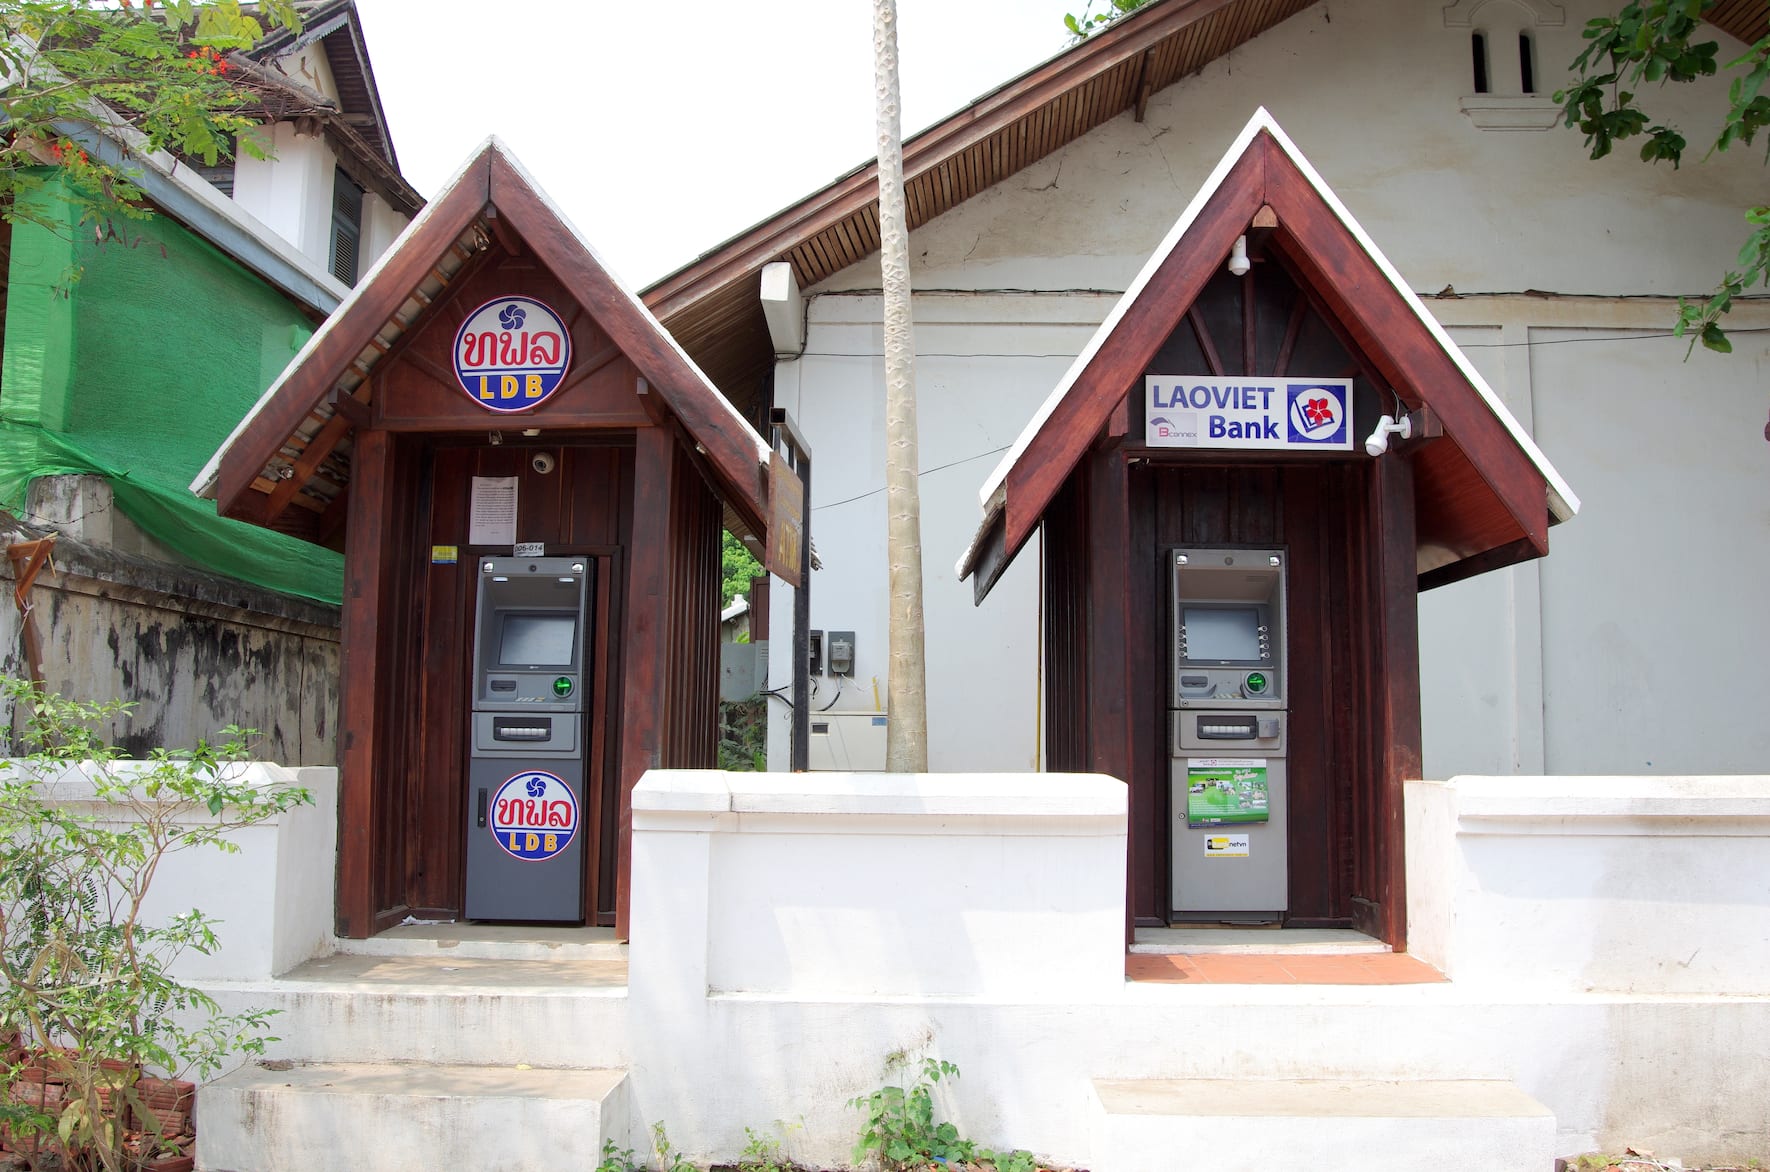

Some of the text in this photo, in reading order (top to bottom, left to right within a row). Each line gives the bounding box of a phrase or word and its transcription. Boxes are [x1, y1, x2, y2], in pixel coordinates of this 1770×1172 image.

[463, 331, 561, 367] ທພລ
[479, 374, 543, 400] LDB
[1153, 385, 1275, 410] LAOVIET
[1209, 415, 1281, 440] Bank
[498, 798, 572, 827] ທພລ
[509, 832, 558, 852] LDB
